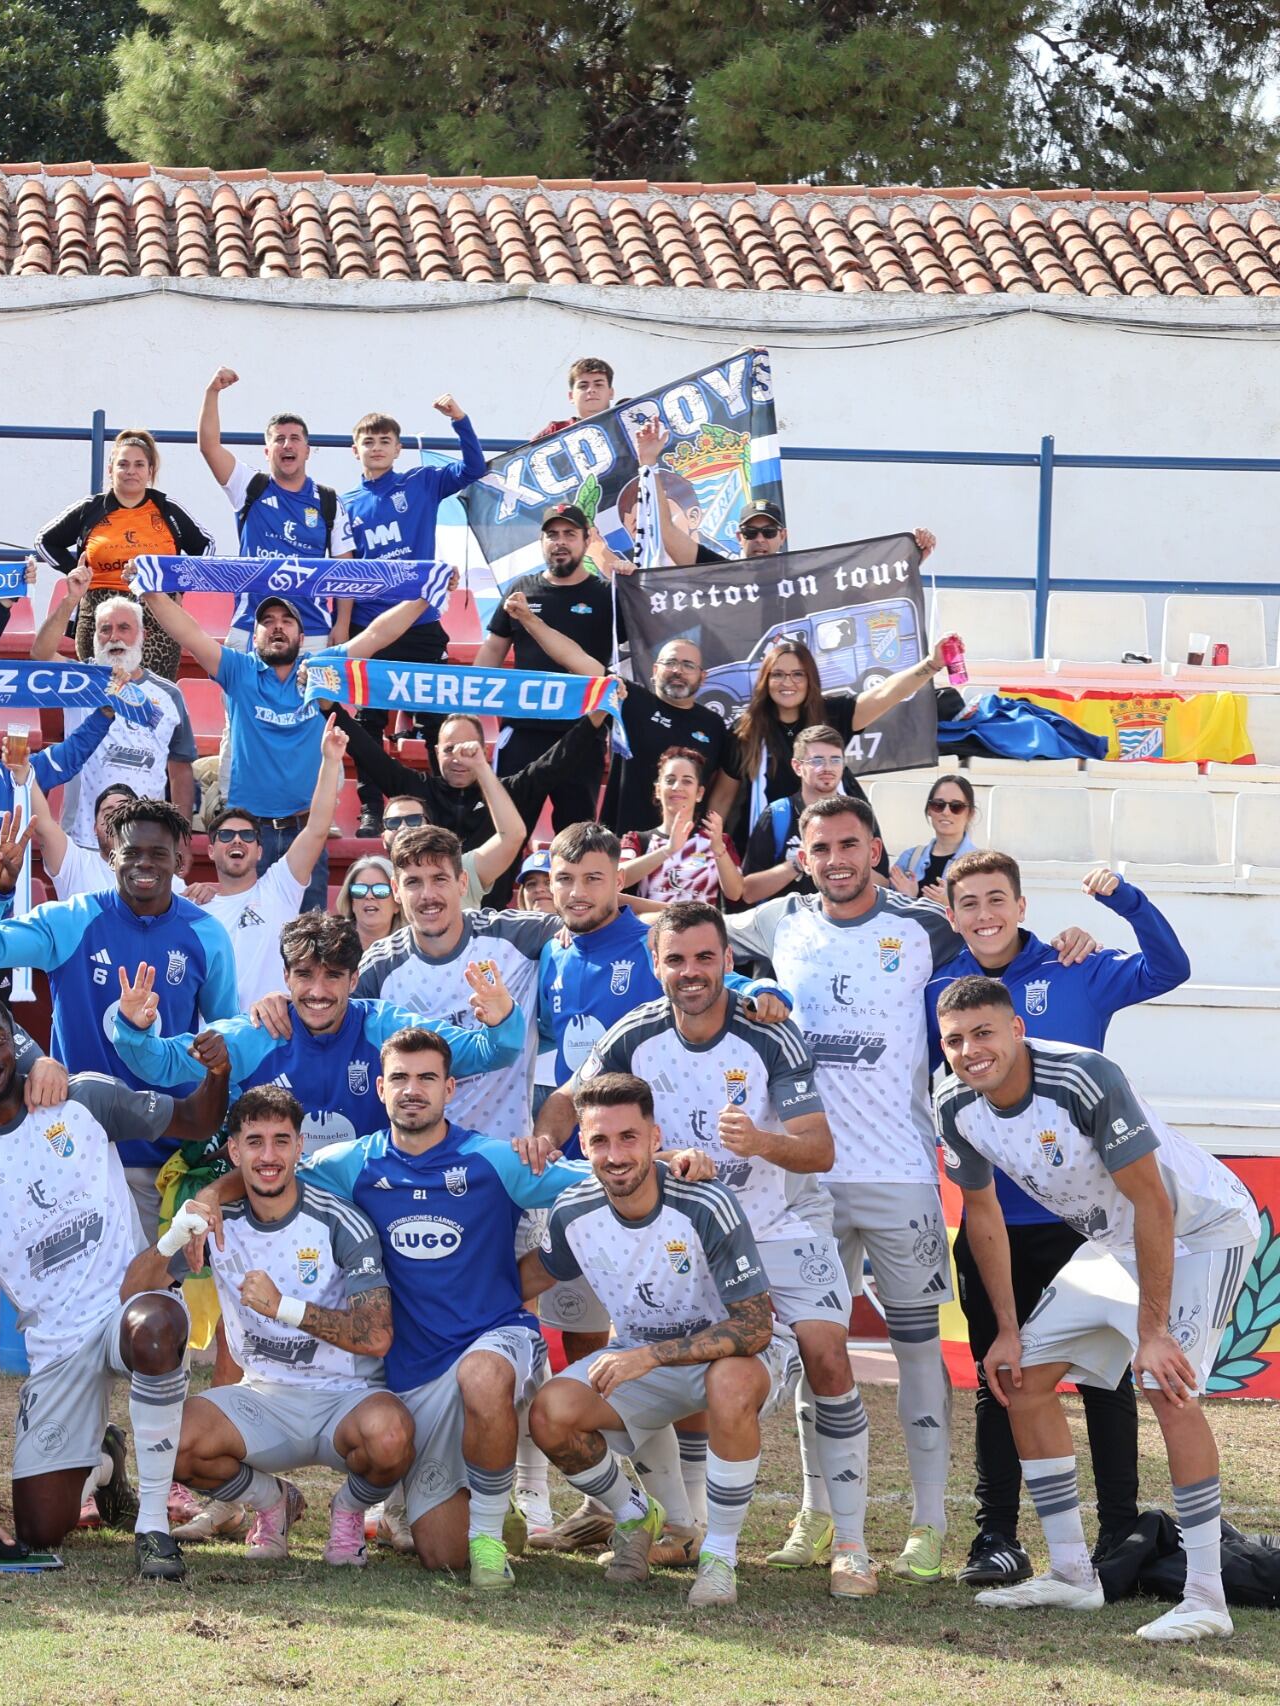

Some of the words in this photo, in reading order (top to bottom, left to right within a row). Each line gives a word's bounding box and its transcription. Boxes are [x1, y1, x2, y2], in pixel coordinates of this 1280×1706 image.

[480, 427, 613, 519] XCD
[321, 581, 385, 594] XEREZ
[650, 583, 760, 614] sector
[777, 577, 818, 599] on
[835, 560, 910, 592] tour
[27, 670, 91, 694] CD
[387, 670, 509, 709] XEREZ
[519, 679, 566, 711] CD
[255, 706, 296, 726] XEREZ
[93, 967, 108, 985] 6
[803, 1030, 886, 1048] Torralva
[413, 1189, 428, 1200] 21
[13, 1191, 89, 1237] LAFLAMENCA
[386, 1214, 432, 1233] DISTRIBUCIONES
[25, 1212, 99, 1260] Torralva
[394, 1232, 458, 1249] LUGO
